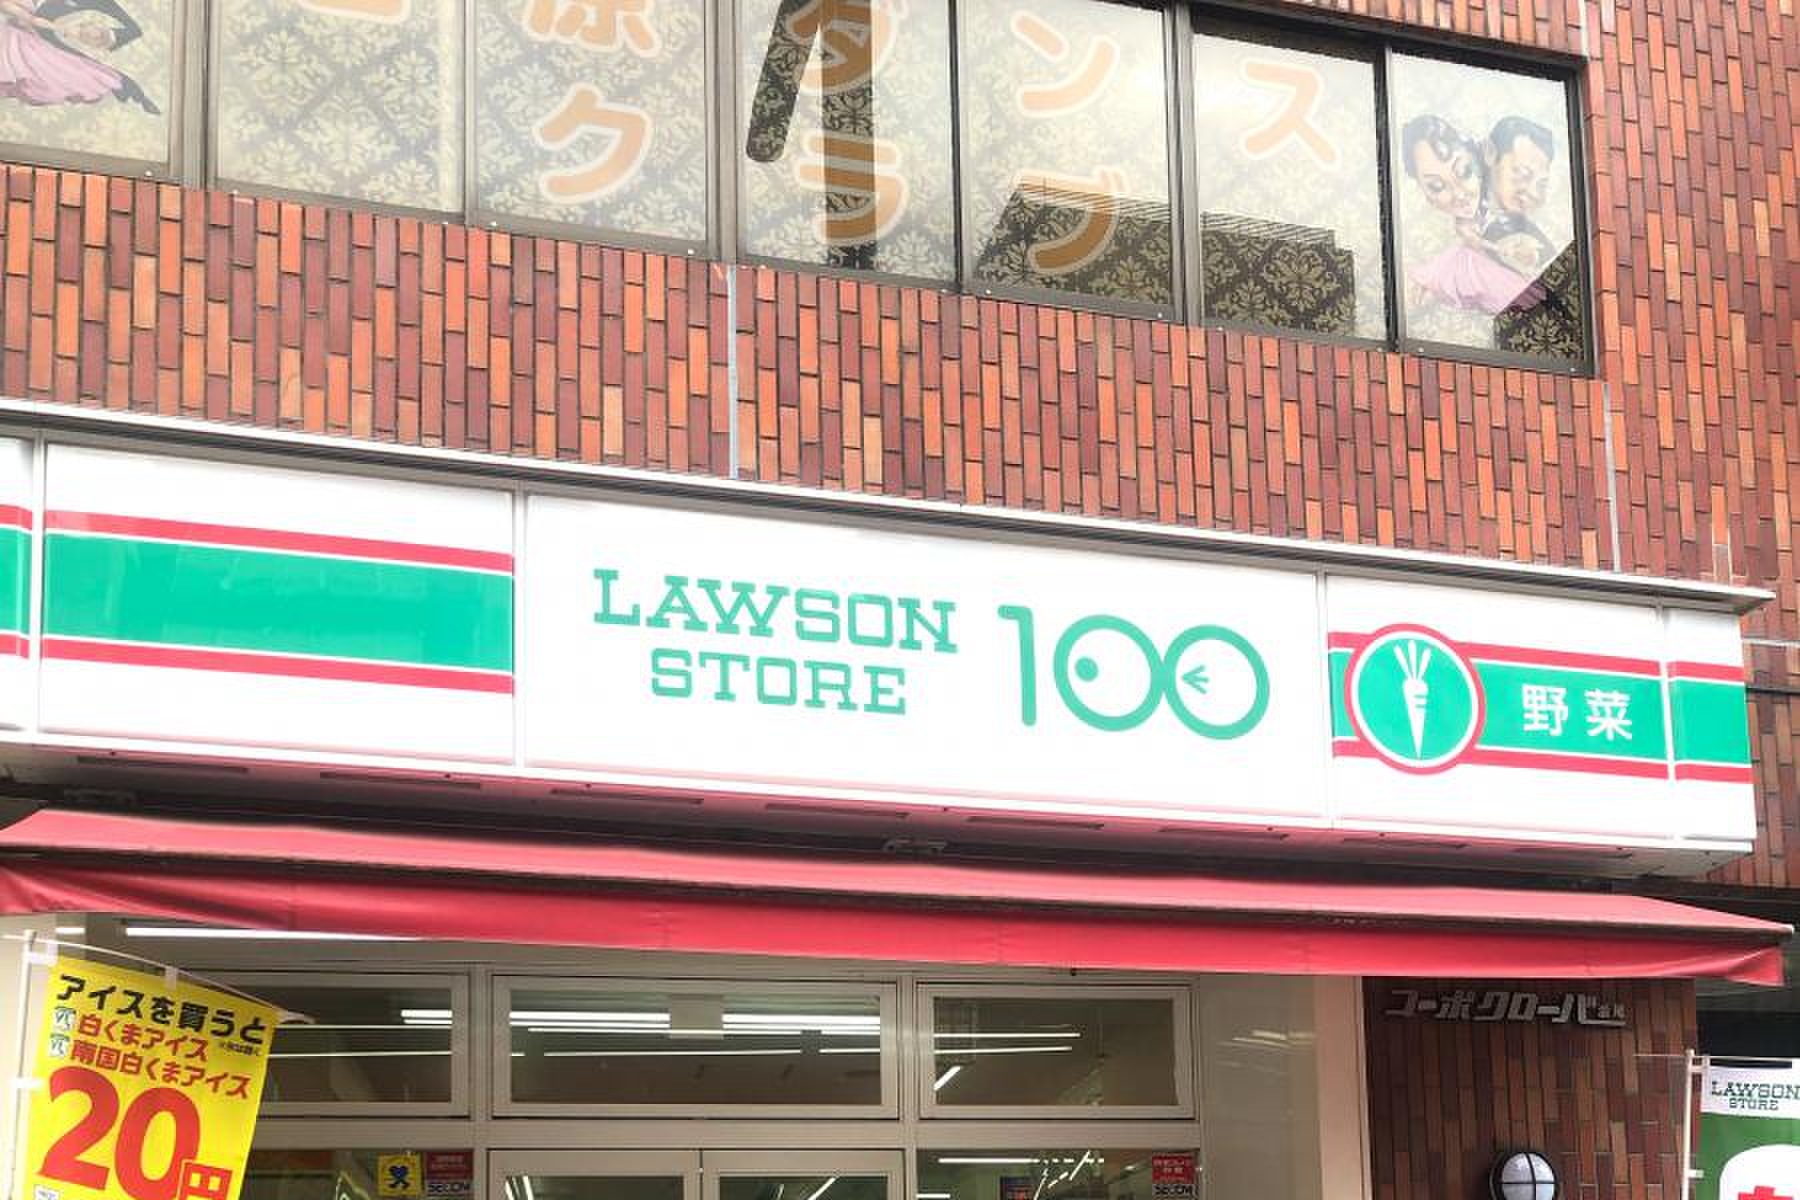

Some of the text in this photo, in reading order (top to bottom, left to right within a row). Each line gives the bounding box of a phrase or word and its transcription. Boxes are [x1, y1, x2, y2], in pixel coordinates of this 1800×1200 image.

[592, 568, 958, 655] LAWSON
[650, 645, 908, 717] STORE
[996, 603, 1272, 742] 100
[1520, 682, 1634, 740] 野菜
[56, 973, 268, 1046] アイスを買うと
[77, 1012, 210, 1063] 白くまアイス
[70, 1038, 252, 1100] 南国白くまアイス
[1711, 1080, 1800, 1100] LAWSON
[1729, 1097, 1779, 1111] STORE
